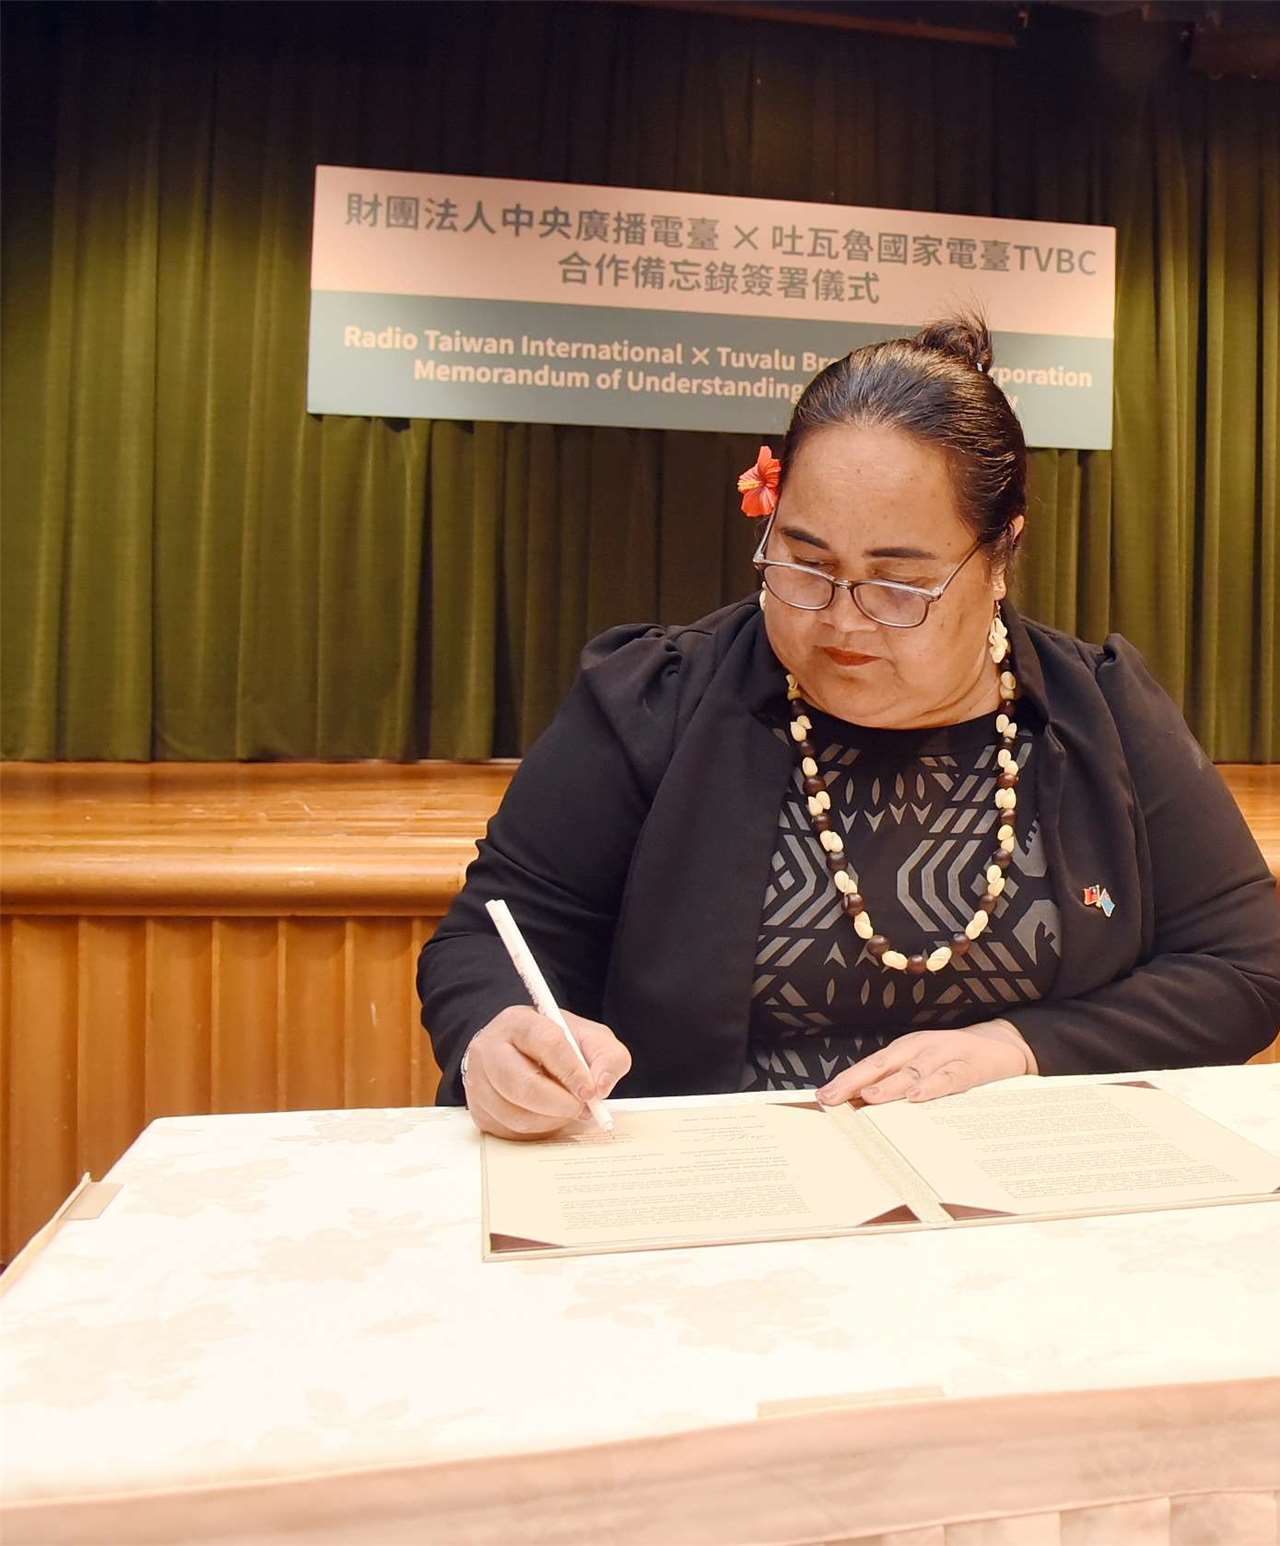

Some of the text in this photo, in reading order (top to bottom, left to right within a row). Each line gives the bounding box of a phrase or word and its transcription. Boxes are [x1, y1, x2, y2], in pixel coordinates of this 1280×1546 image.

[345, 193, 719, 250] 財團法人中央廣播電臺
[558, 251, 880, 304] 合作備忘錄簽署儀式
[343, 325, 418, 351] Radio
[424, 329, 514, 356] Taiwan
[521, 335, 683, 365] International
[716, 346, 796, 371] Tuvalu
[988, 365, 1093, 387] rporation
[414, 359, 803, 404] Memorandum of Understanding
